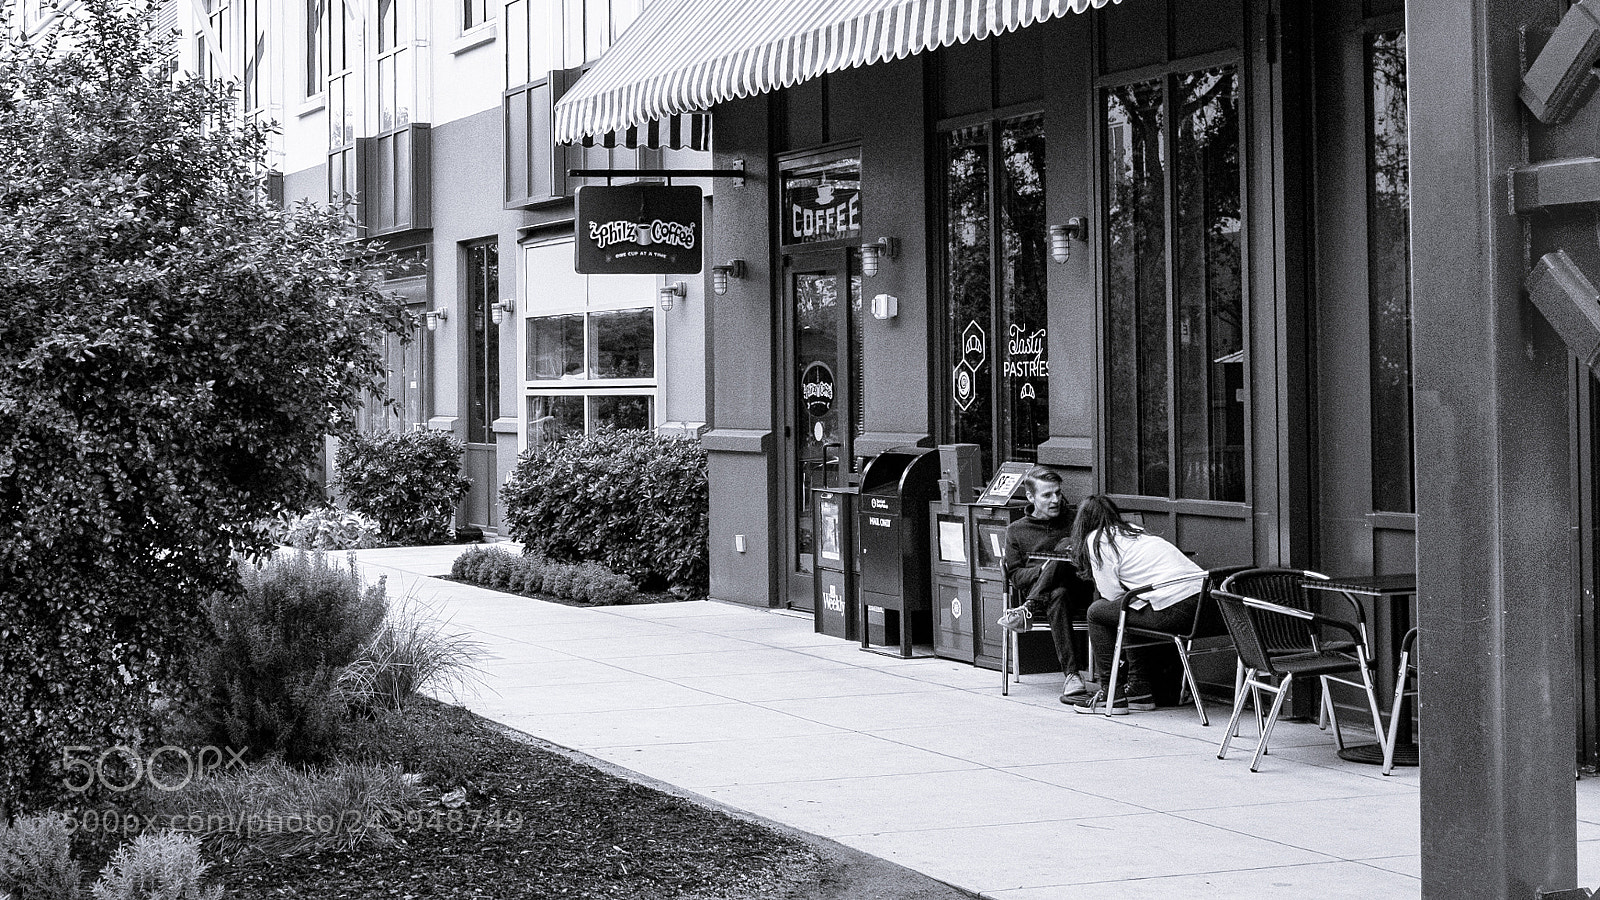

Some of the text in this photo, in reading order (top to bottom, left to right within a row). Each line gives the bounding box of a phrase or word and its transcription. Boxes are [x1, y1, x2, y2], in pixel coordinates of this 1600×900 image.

[792, 191, 861, 238] COFFEE
[589, 219, 696, 249] Philz Coffee
[1008, 322, 1046, 371] Tasty
[822, 591, 846, 617] Weekly
